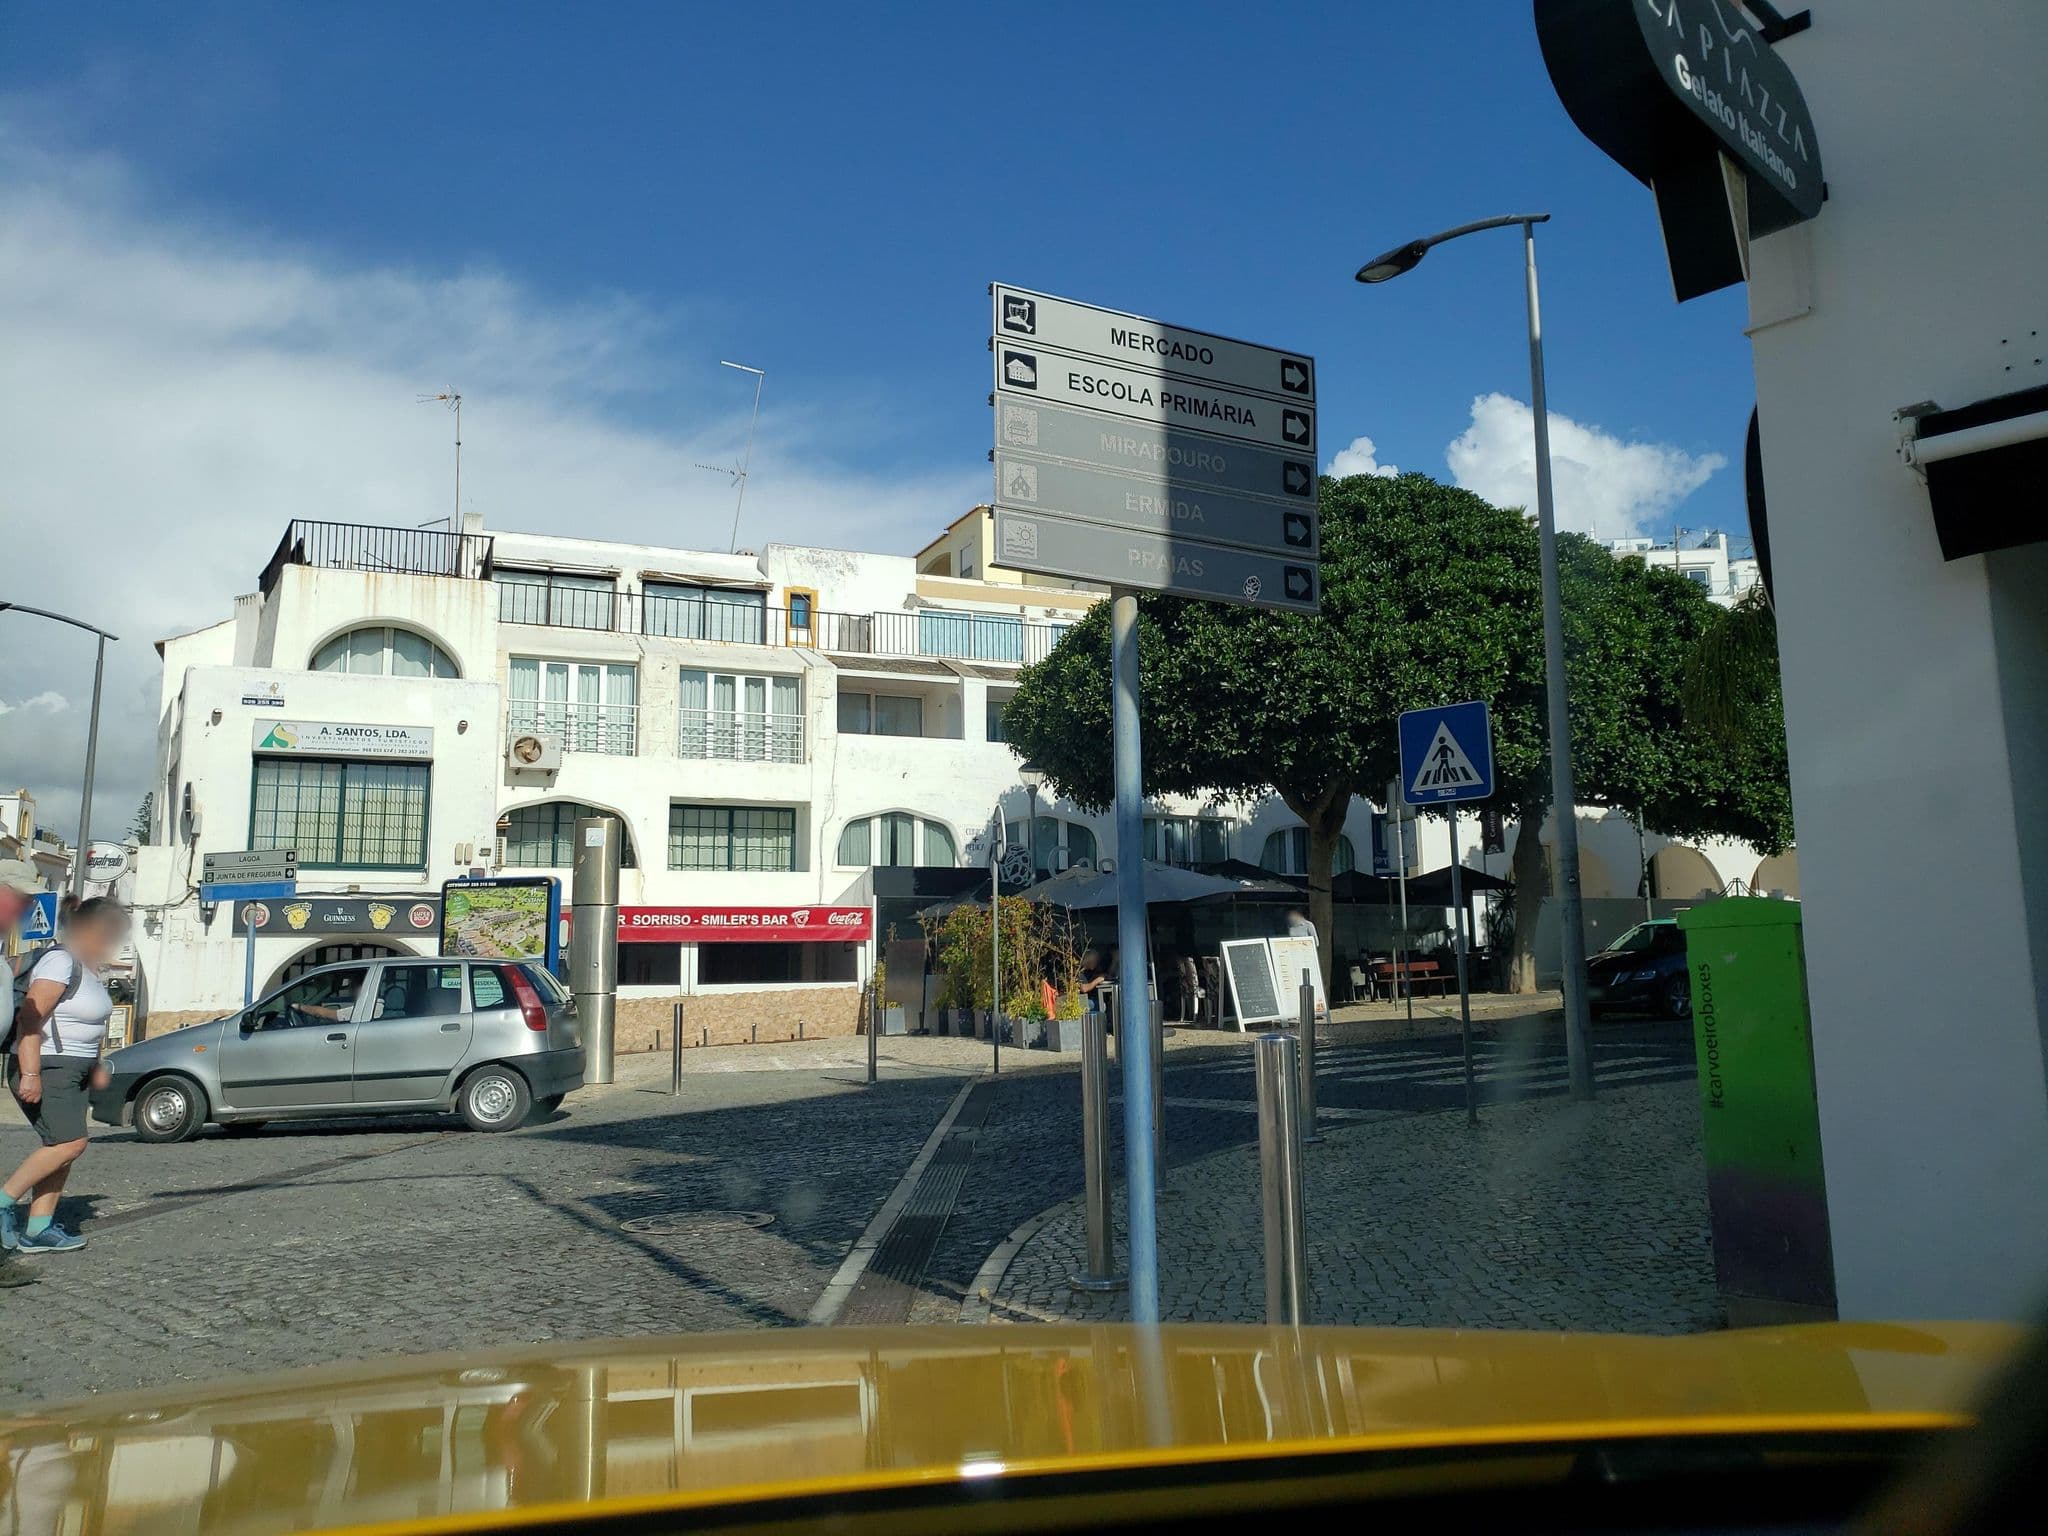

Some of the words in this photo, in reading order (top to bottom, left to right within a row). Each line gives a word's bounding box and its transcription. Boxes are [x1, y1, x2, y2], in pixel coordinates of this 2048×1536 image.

[1700, 23, 1808, 163] PIAZZA
[1675, 54, 1736, 131] Gelato
[1738, 111, 1797, 190] Italiano
[1111, 327, 1214, 365] MERCADO
[1068, 372, 1154, 406] ESCOLA
[1160, 391, 1257, 428] PRIMÁRIA
[1101, 432, 1226, 473] MIRADOURO
[1125, 491, 1205, 523] ERMIDA
[1127, 548, 1205, 577] PRAIAS
[320, 727, 332, 735] A.
[335, 727, 382, 738] SANTOS,
[385, 730, 410, 739] LDA.
[247, 870, 282, 878] FREGUESIA
[323, 914, 356, 922] GUINNESS
[632, 914, 691, 925] SORRISO
[701, 914, 759, 925] SMILER'S
[762, 914, 788, 925] BAR
[1696, 963, 1725, 1110] #carvoeiroboxes
